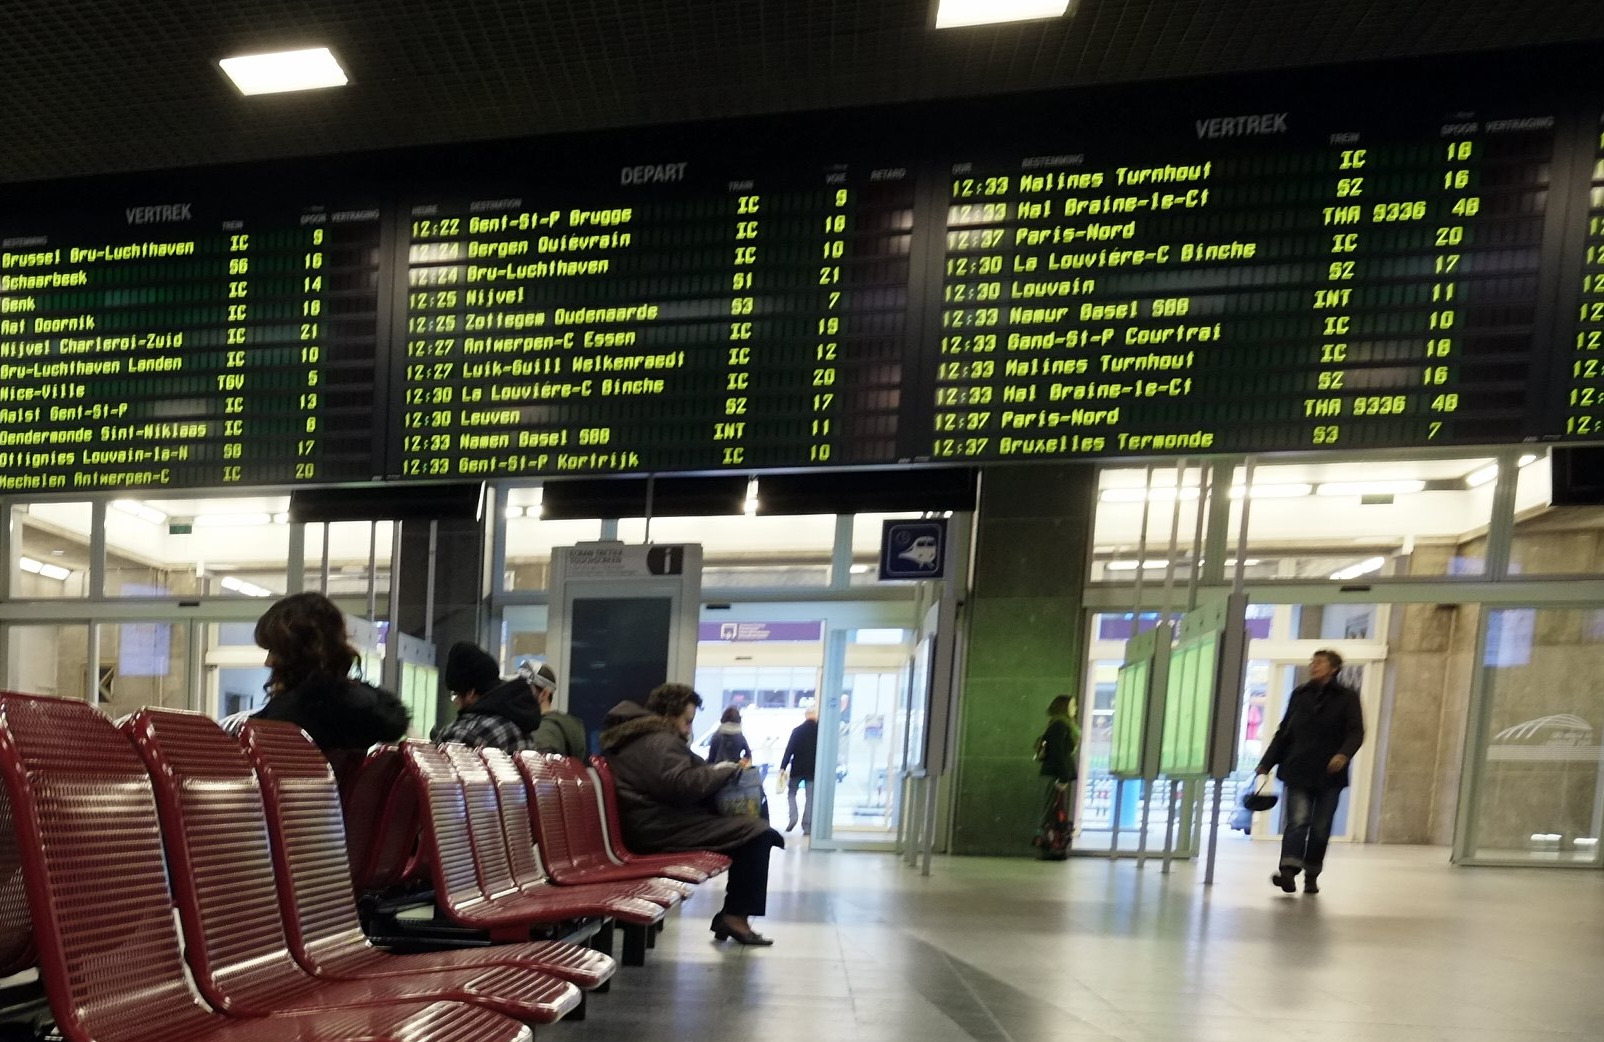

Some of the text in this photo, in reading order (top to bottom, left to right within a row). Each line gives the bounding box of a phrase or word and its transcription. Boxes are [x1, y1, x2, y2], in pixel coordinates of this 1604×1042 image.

[1195, 112, 1289, 140] VERTREK
[620, 162, 688, 186] DEPART
[1019, 172, 1104, 193] Malines
[1115, 161, 1212, 186] Turnhout
[1339, 149, 1367, 170] IC
[125, 202, 193, 225] VERTREK
[469, 210, 561, 234] Gent-St-P
[569, 208, 632, 227] Brugge
[737, 195, 760, 215] IC
[1064, 188, 1209, 217] Braine-le-Ct
[467, 221, 759, 259] Bergen IC
[1015, 220, 1136, 246] Paris-Nord
[2, 248, 61, 269] Brussel
[69, 241, 195, 264] Bru-Luchthaven
[230, 234, 249, 252] IC
[1013, 254, 1038, 273] La
[1180, 240, 1257, 262] Binche
[1331, 233, 1359, 253] IC
[465, 246, 757, 283] Bru-Luchthaven IC
[0, 270, 88, 293] Schaarbeek
[1011, 277, 1095, 299] Louvain
[0, 295, 36, 314] Genk
[228, 281, 248, 299] IC
[466, 286, 524, 307] Nijvel
[1009, 306, 1069, 325] Namur
[1079, 300, 1138, 321] Basel
[1313, 288, 1353, 309] INT
[34, 314, 96, 334] Doornik
[227, 304, 247, 321] IC
[554, 303, 659, 326] Oudenaarde
[463, 332, 574, 354] Antwerpen-C
[583, 330, 636, 348] Essen
[1007, 328, 1115, 351] Gand-St-P
[1125, 323, 1221, 345] Courtrai
[1323, 316, 1350, 336] IC
[0, 339, 50, 359] Nijvel
[1005, 357, 1089, 376] Malines
[1100, 350, 1195, 373] Turnhout
[1320, 343, 1348, 363] IC
[0, 360, 121, 380] Bru-Luchthaven
[128, 355, 183, 373] Landen
[462, 357, 561, 379] Luik-Guill
[0, 383, 86, 402] Nice-Ville
[217, 374, 245, 391] TGV
[461, 385, 482, 402] La
[601, 377, 665, 396] Binche
[1049, 377, 1192, 401] Braine-le-Ct
[0, 402, 128, 424] Aalst Gent-St-P
[460, 409, 521, 426] Leuven
[1001, 407, 1120, 429] Paris-Nord
[0, 422, 207, 446] Dendermonde Sint-Niklaas
[459, 433, 510, 450] Namen
[518, 429, 567, 448] Basel
[713, 422, 746, 440] INT
[999, 435, 1105, 454] Bruxelles
[1117, 430, 1214, 450] Termonde
[458, 454, 549, 474] Gent-St-P
[557, 451, 639, 470] Kortrijk
[73, 468, 170, 487] Antwerpen-C
